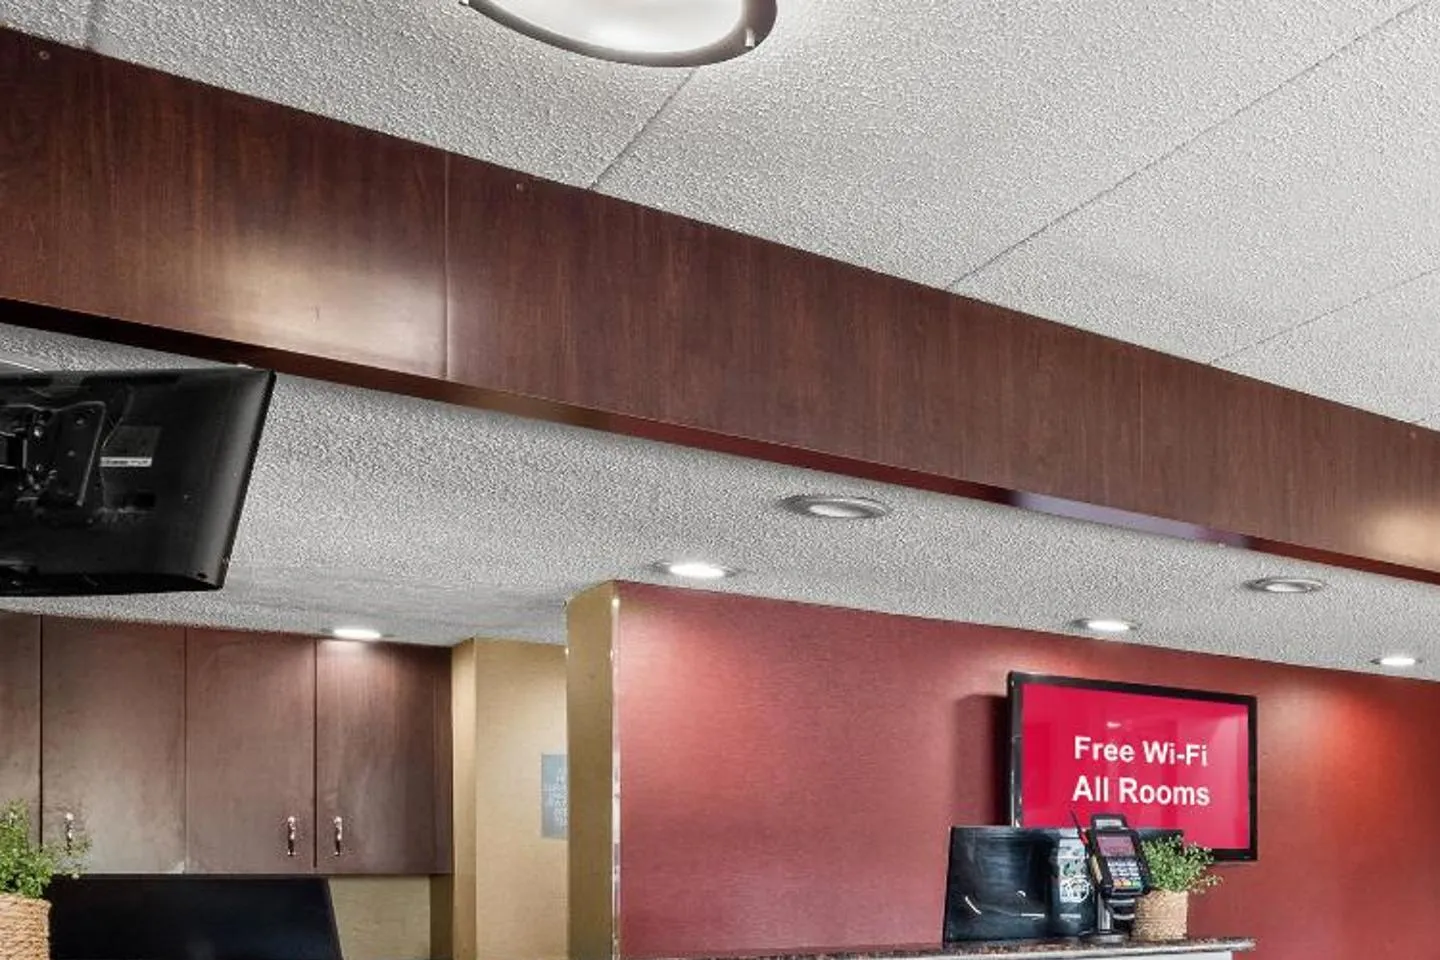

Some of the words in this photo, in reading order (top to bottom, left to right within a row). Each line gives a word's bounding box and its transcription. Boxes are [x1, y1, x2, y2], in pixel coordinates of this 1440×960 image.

[1074, 735, 1135, 762] Free
[1142, 740, 1208, 767] Wi-Fi
[1072, 775, 1109, 802] All
[1119, 777, 1210, 806] Rooms
